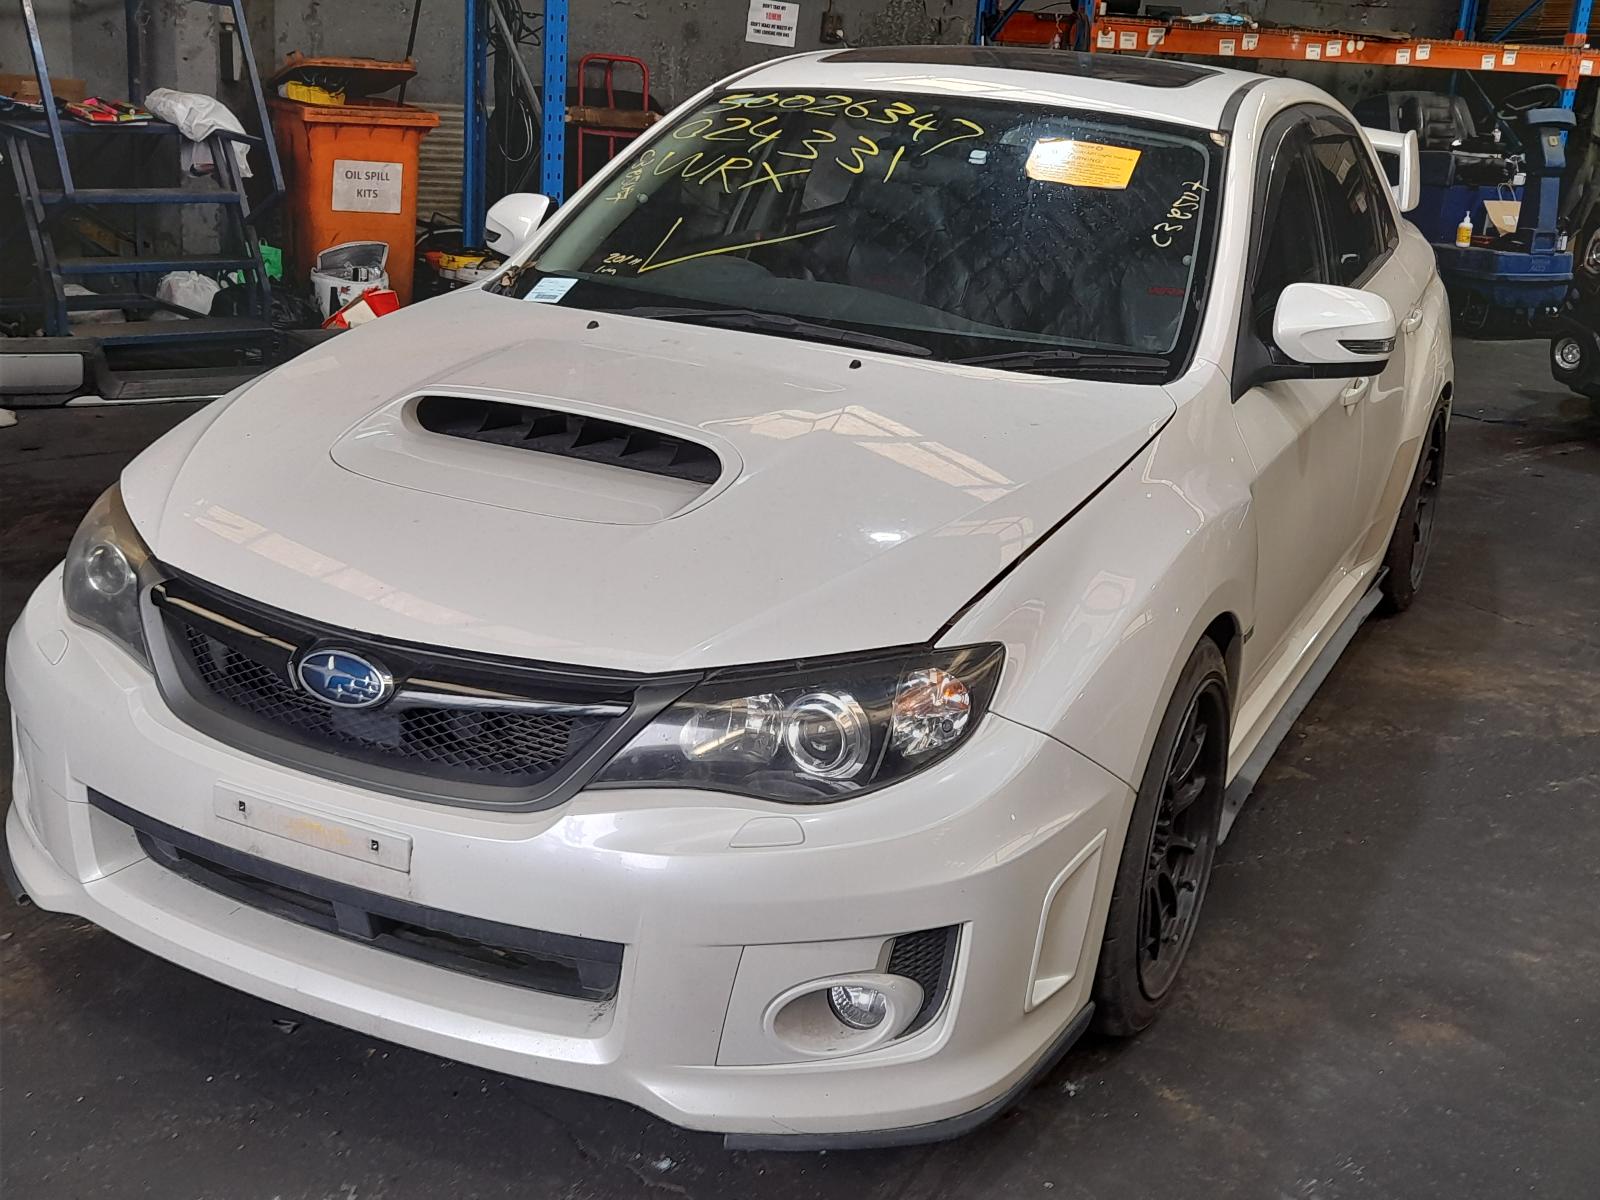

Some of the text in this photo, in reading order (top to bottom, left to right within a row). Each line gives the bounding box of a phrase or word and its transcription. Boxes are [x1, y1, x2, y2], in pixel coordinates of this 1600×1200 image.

[345, 170, 390, 181] OIL SPILL
[653, 150, 811, 194] WRX
[356, 188, 378, 198] KITS
